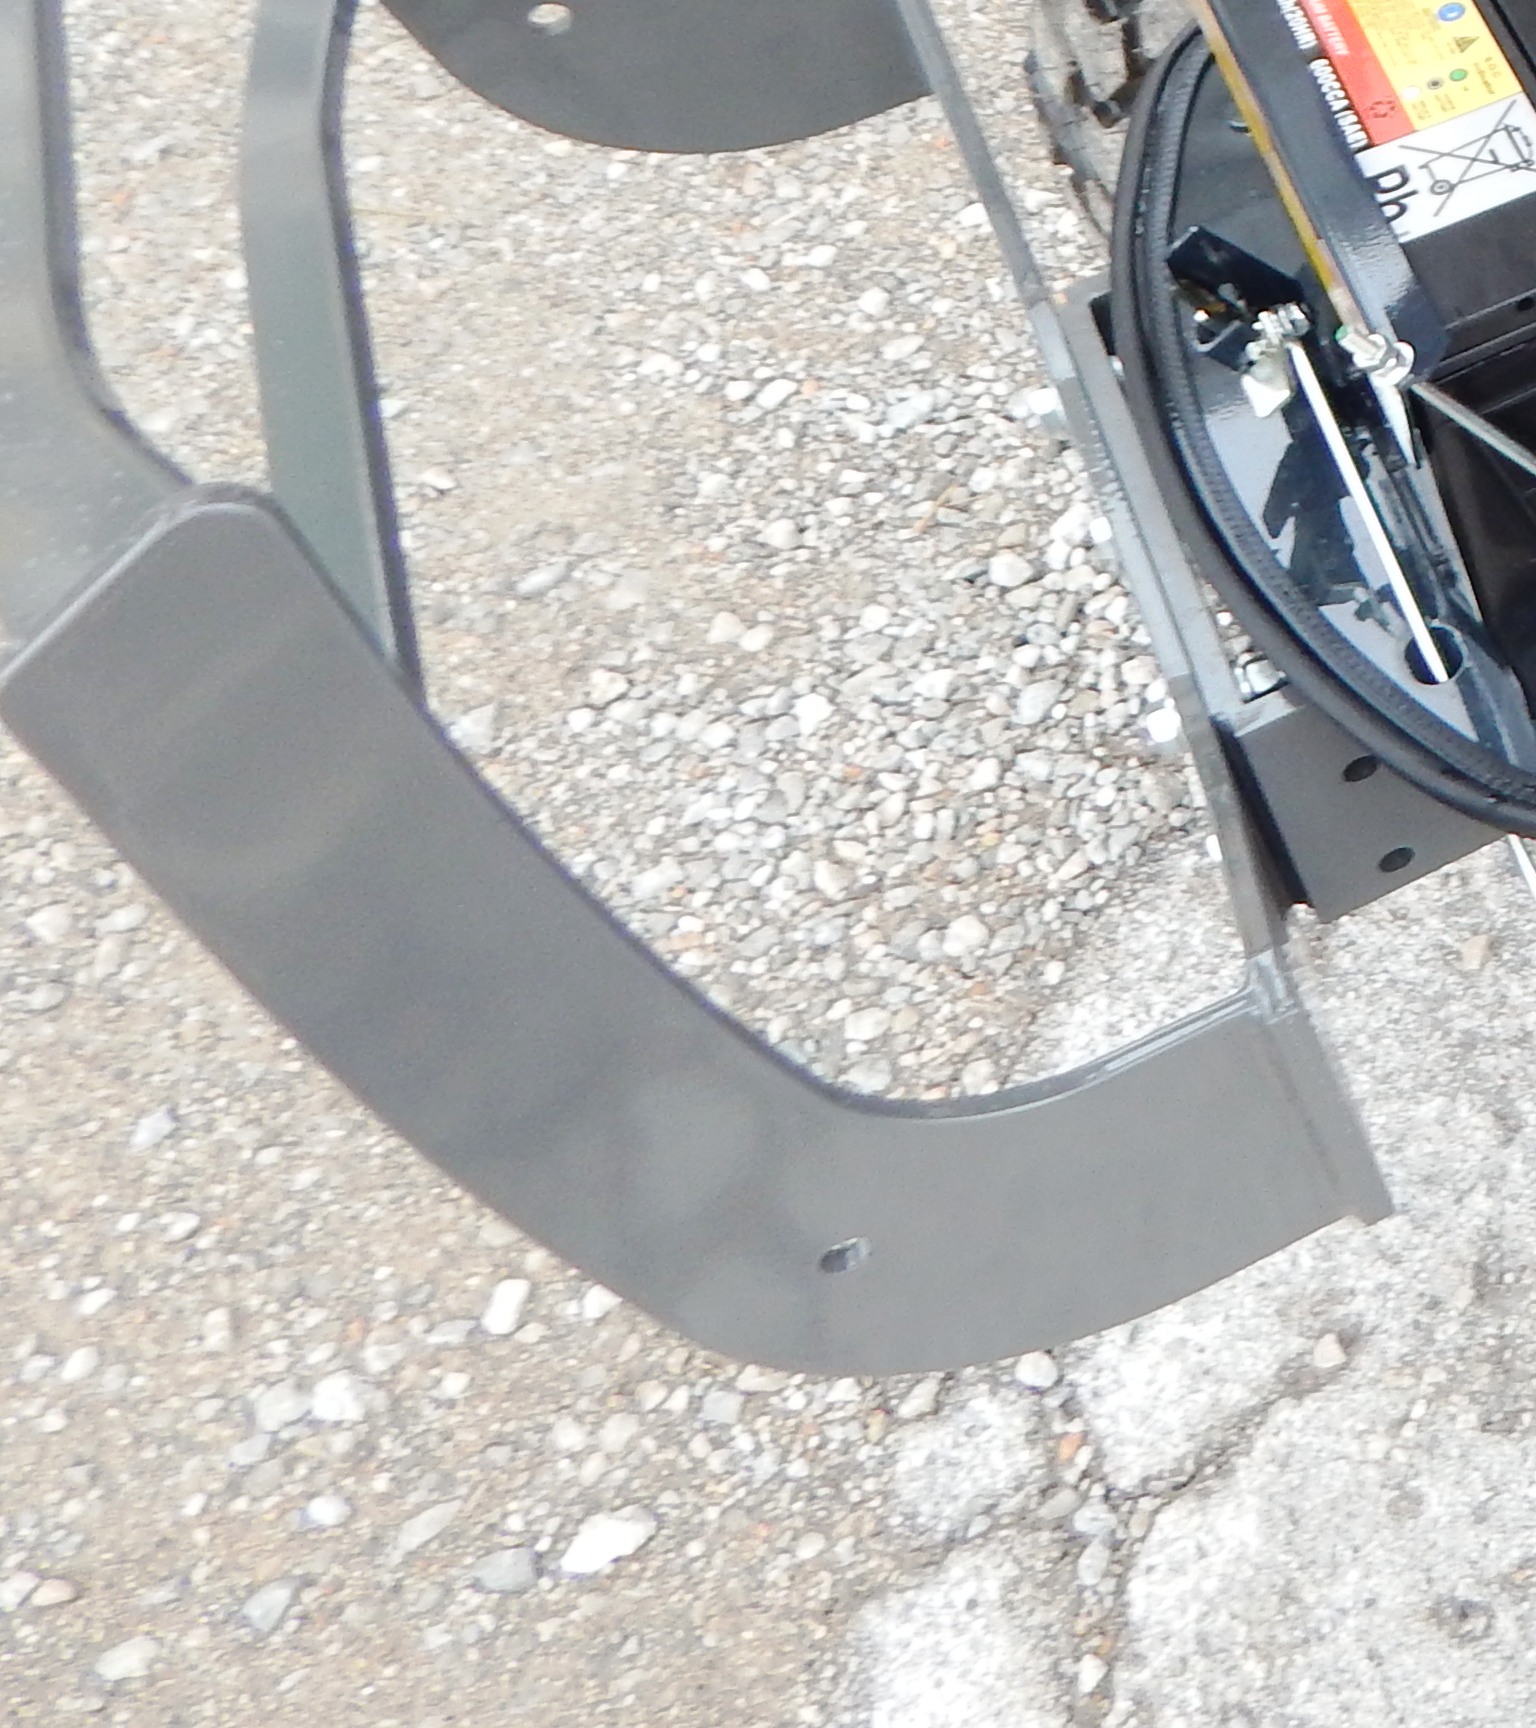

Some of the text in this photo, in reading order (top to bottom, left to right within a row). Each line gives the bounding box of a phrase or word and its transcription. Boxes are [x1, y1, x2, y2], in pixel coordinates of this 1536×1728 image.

[1315, 13, 1350, 54] BATTERY
[1309, 58, 1350, 111] 600CCA
[1364, 165, 1418, 223] Pb
